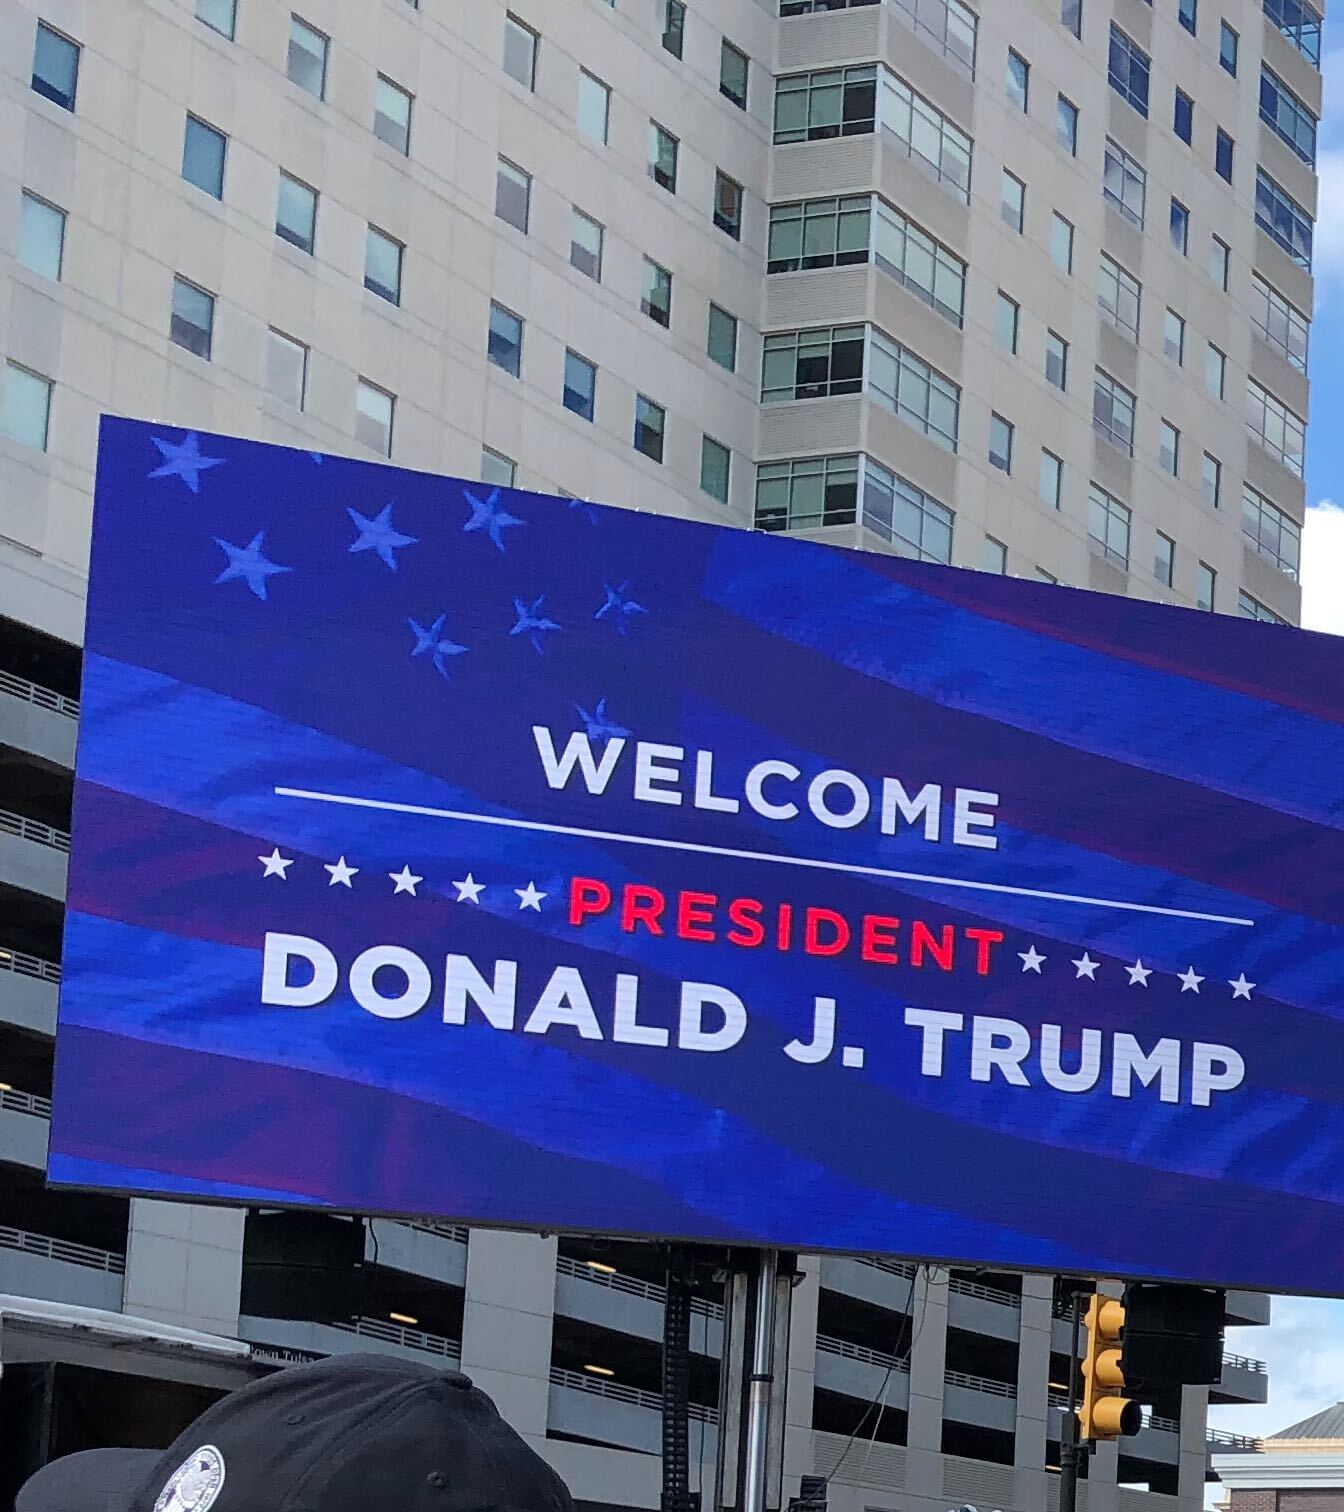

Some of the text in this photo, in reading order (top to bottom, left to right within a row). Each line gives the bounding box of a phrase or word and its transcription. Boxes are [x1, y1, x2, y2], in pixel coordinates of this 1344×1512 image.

[532, 725, 999, 848] WELCOME
[569, 876, 1004, 976] PRESIDENT
[260, 930, 1246, 1108] DONALD J. TRUMP
